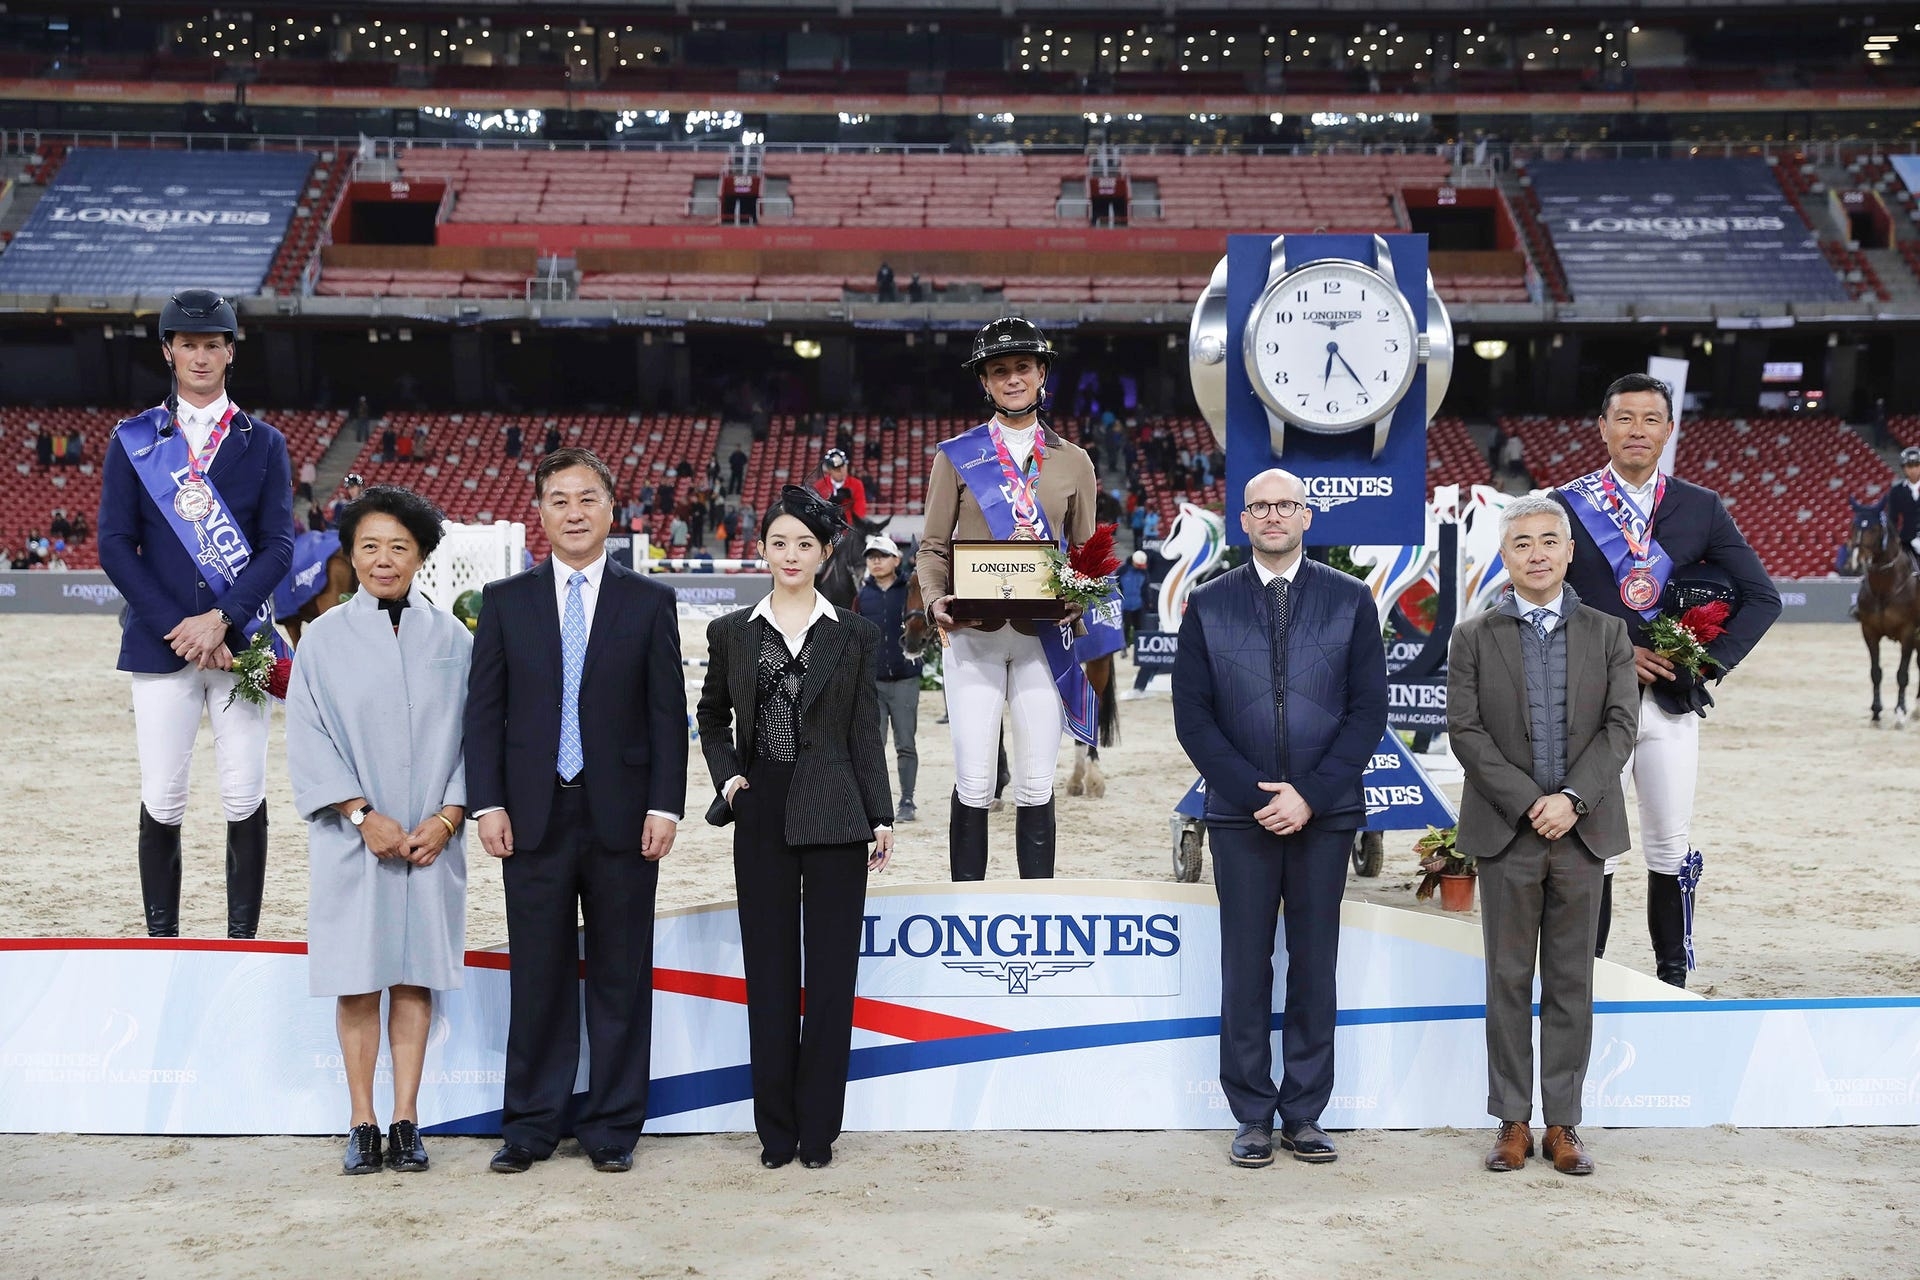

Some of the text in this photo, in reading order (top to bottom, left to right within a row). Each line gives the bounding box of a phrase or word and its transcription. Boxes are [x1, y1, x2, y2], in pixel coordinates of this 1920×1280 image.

[50, 207, 271, 226] LONGINES
[1566, 216, 1785, 232] LONGINES
[1323, 281, 1341, 294] 12
[1297, 290, 1308, 302] 11
[1361, 290, 1366, 301] 1
[1276, 311, 1293, 324] 10
[1302, 311, 1362, 321] LONGINES
[1377, 309, 1390, 322] 2
[1266, 342, 1279, 355] 9
[1384, 339, 1399, 353] 3
[1275, 371, 1289, 385] 8
[1375, 369, 1390, 383] 4
[1297, 393, 1310, 407] 7
[1356, 392, 1369, 405] 5
[1326, 401, 1339, 414] 6
[971, 563, 1036, 573] LONGINES
[62, 584, 119, 598] LONGIN
[1388, 684, 1447, 709] INES
[1388, 713, 1407, 722] RIAN
[858, 914, 1181, 957] LONGINES
[109, 1070, 198, 1083] MASTERS
[1604, 1095, 1692, 1107] MASTERS
